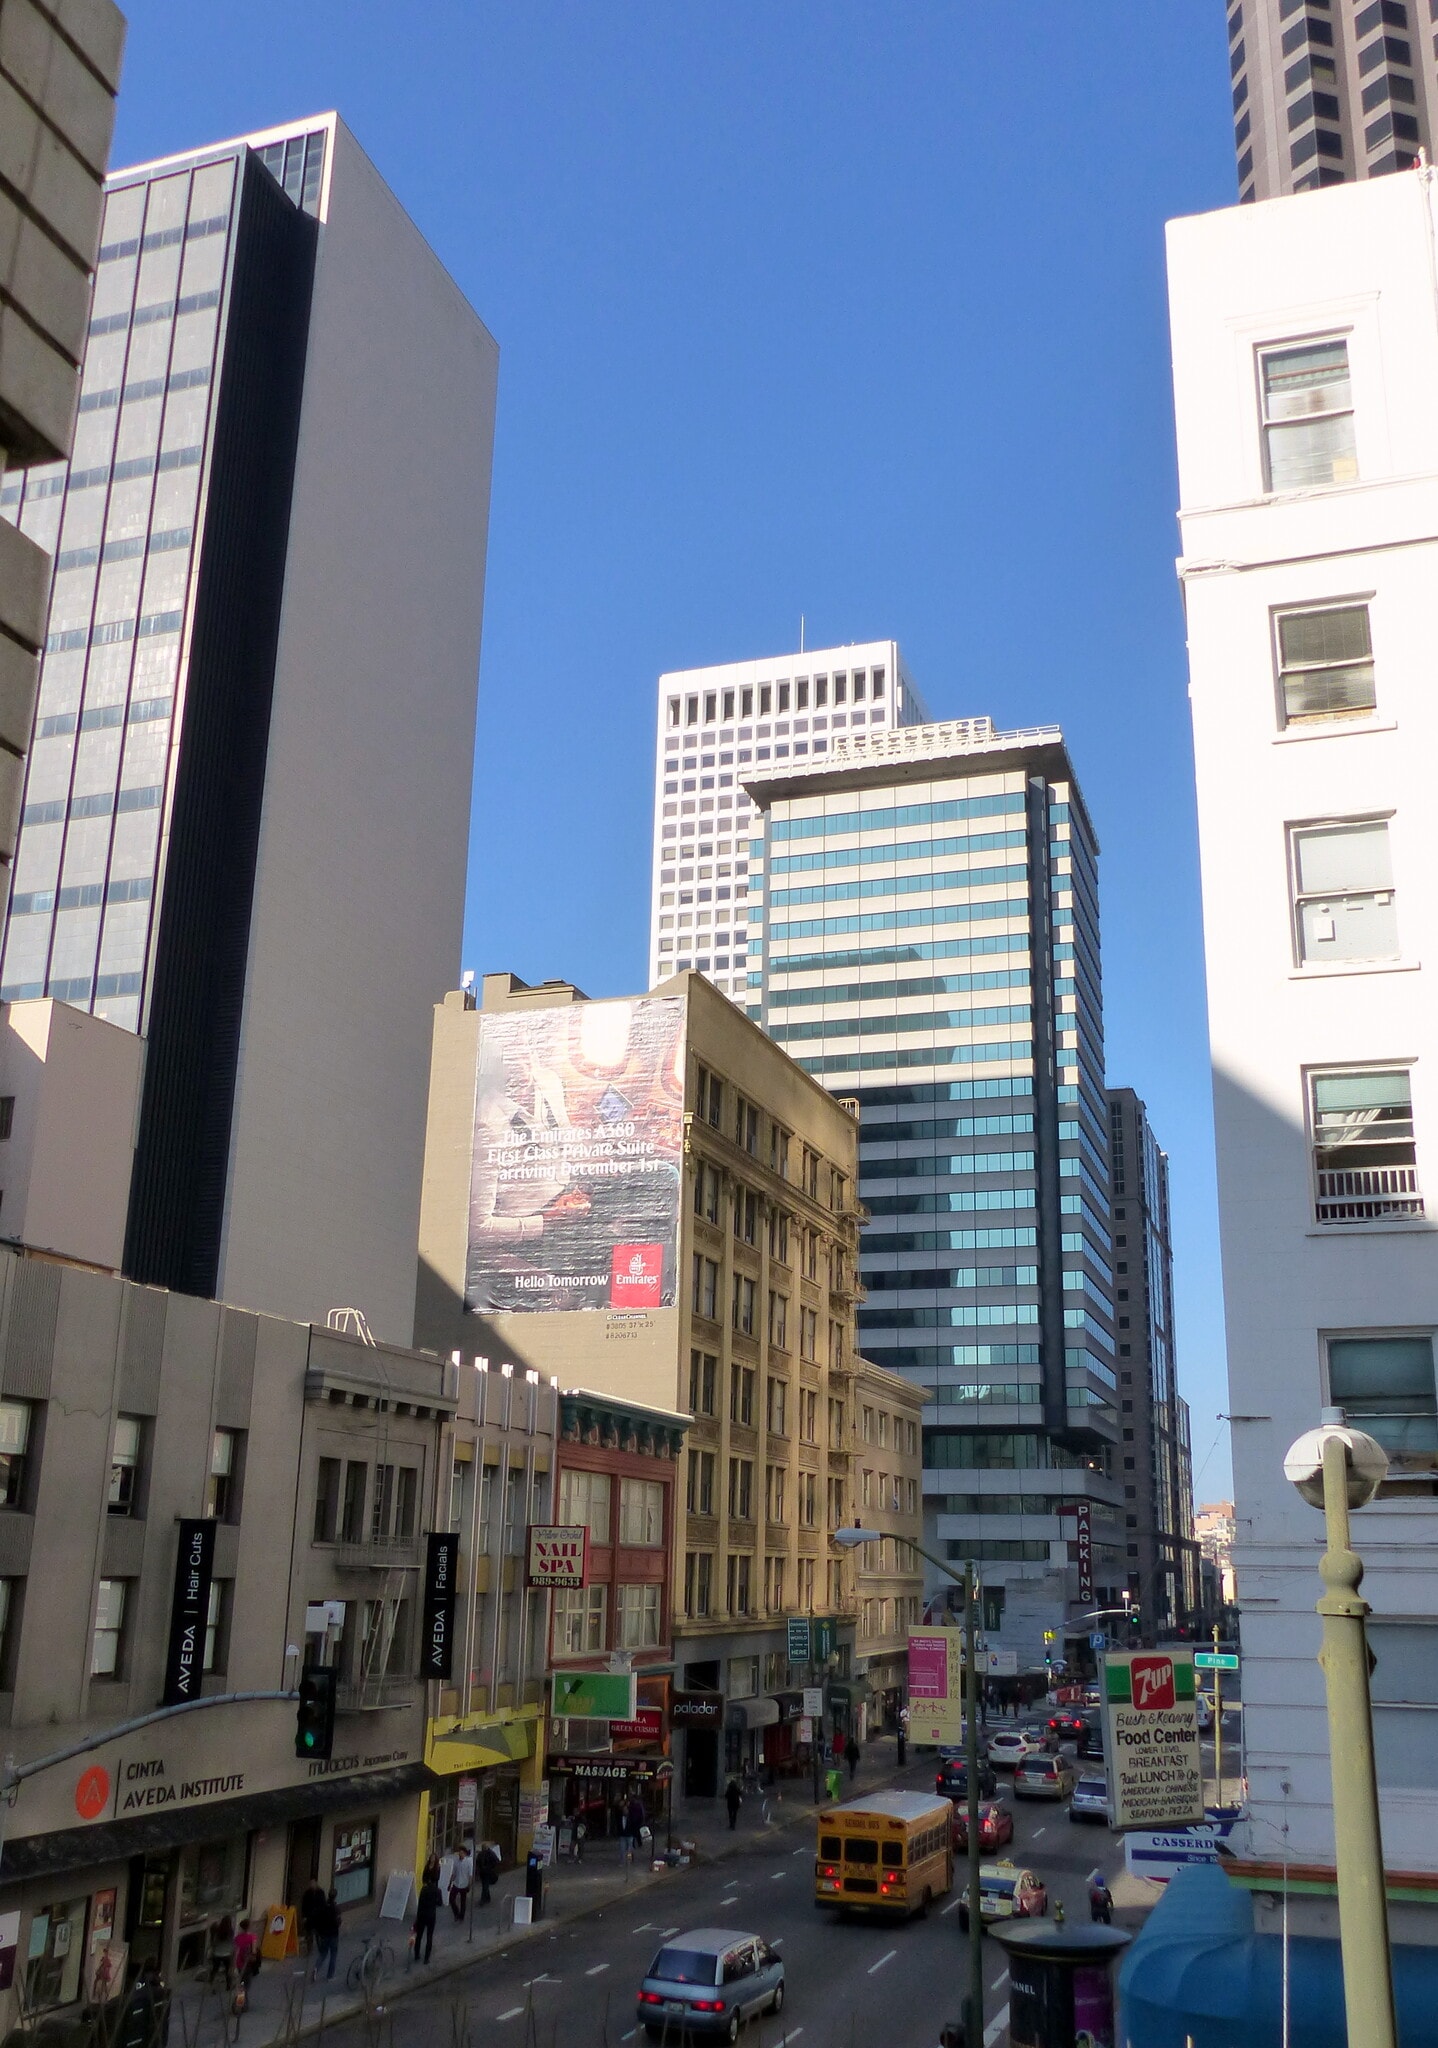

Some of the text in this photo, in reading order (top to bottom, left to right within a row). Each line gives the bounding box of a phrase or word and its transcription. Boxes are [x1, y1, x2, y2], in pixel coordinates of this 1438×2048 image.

[503, 1122, 635, 1144] The Emirates A380
[488, 1139, 655, 1163] First Class Private Suite
[500, 1158, 660, 1181] arriving December 1st
[515, 1275, 609, 1288] Hello Tomorrow
[616, 1275, 658, 1285] Emirates
[534, 1543, 581, 1557] NAIL
[1078, 1506, 1091, 1601] PARKING
[538, 1559, 574, 1573] SPA
[532, 1577, 580, 1586] 989-9633
[178, 1532, 203, 1693] AVEDA Hair Cuts
[432, 1545, 448, 1666] AVEDA Facials
[1207, 1656, 1226, 1665] Pine
[674, 1701, 718, 1715] paladar
[1116, 1712, 1146, 1727] Bush
[1148, 1713, 1155, 1725] &
[1116, 1727, 1197, 1746] Food Center
[1134, 1745, 1182, 1755] LOWER LEVEL
[1128, 1754, 1189, 1768] BREAKFAST
[126, 1760, 165, 1780] CINTA
[575, 1765, 627, 1778] MASSAGE
[1139, 1770, 1175, 1783] LUNCH
[123, 1773, 245, 1810] AVEDA INSTITUTE
[1121, 1782, 1198, 1796] AMERICAN CHINESE
[1129, 1805, 1194, 1819] SEAFOOD PIZZA
